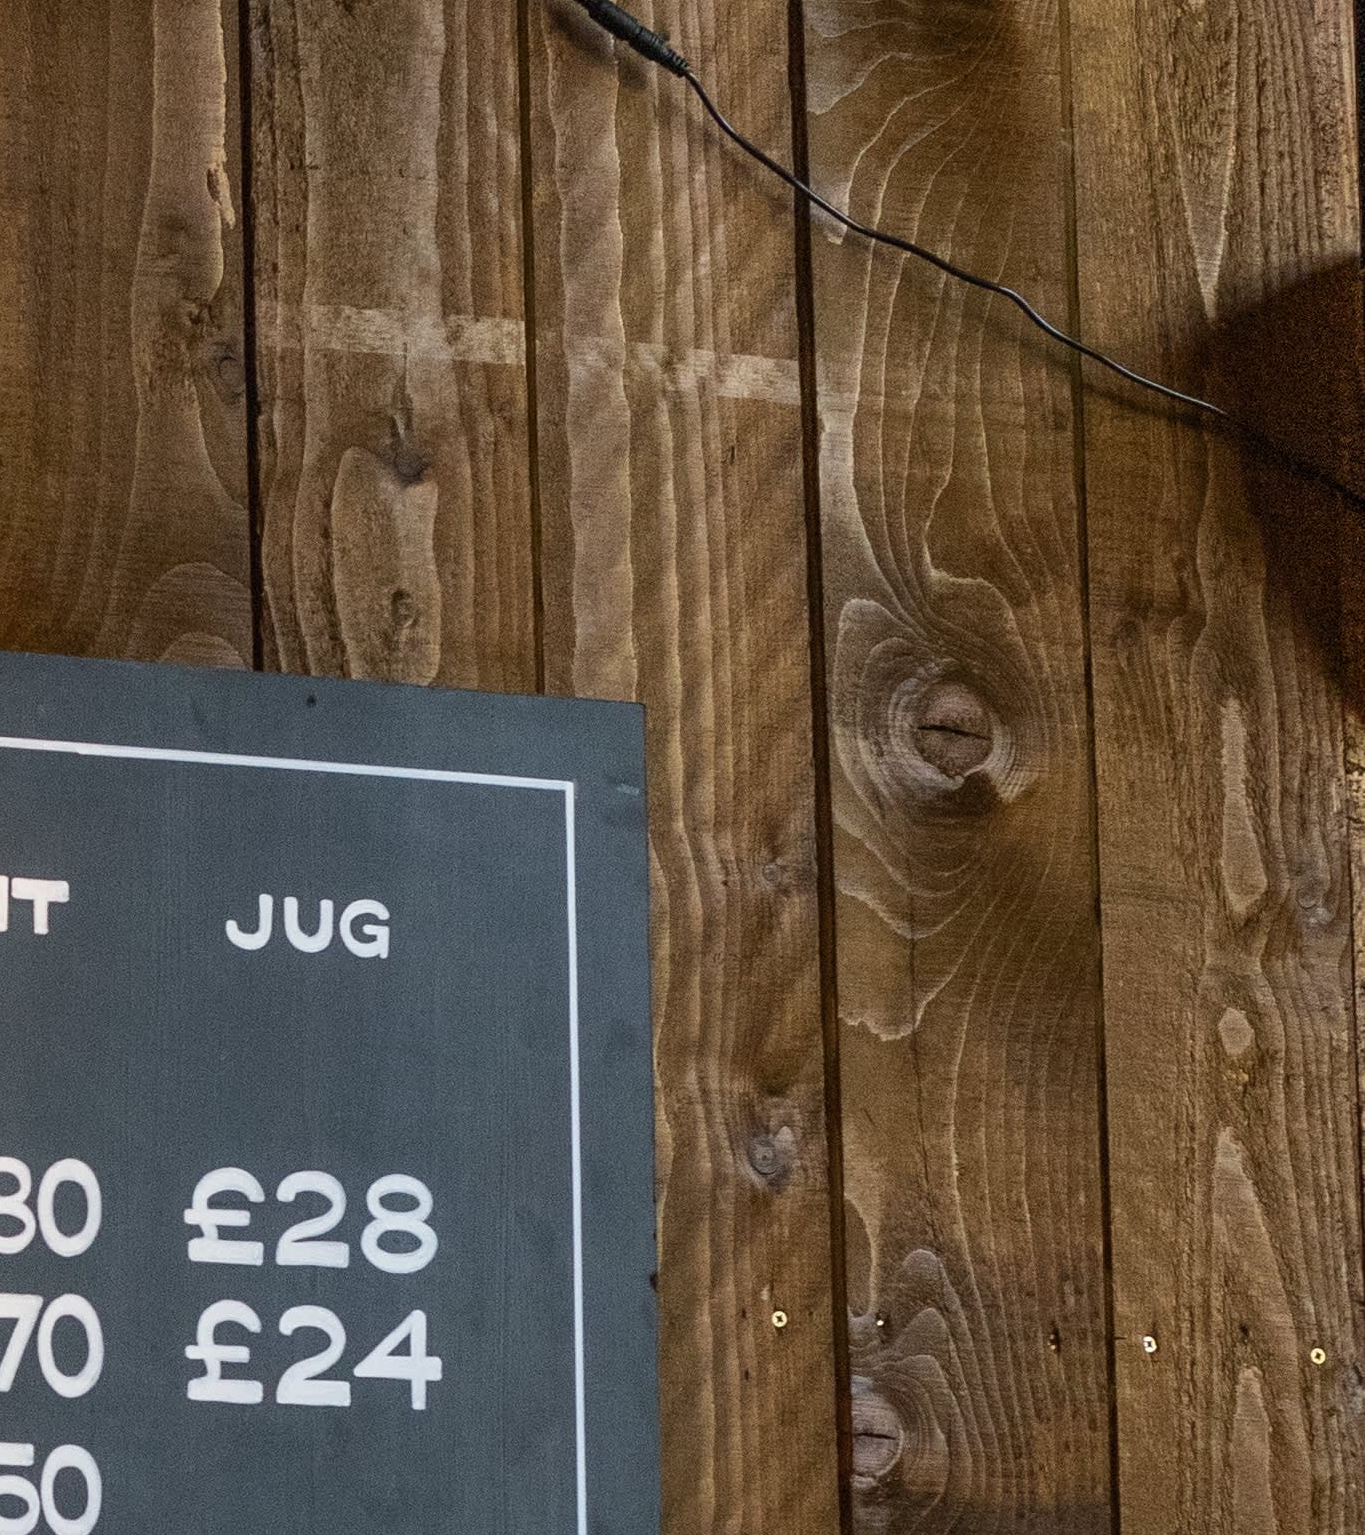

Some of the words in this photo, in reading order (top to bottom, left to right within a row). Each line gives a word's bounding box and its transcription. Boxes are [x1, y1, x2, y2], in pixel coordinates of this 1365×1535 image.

[224, 892, 390, 959] JUG
[183, 1166, 439, 1275] £28
[184, 1299, 443, 1411] £24
